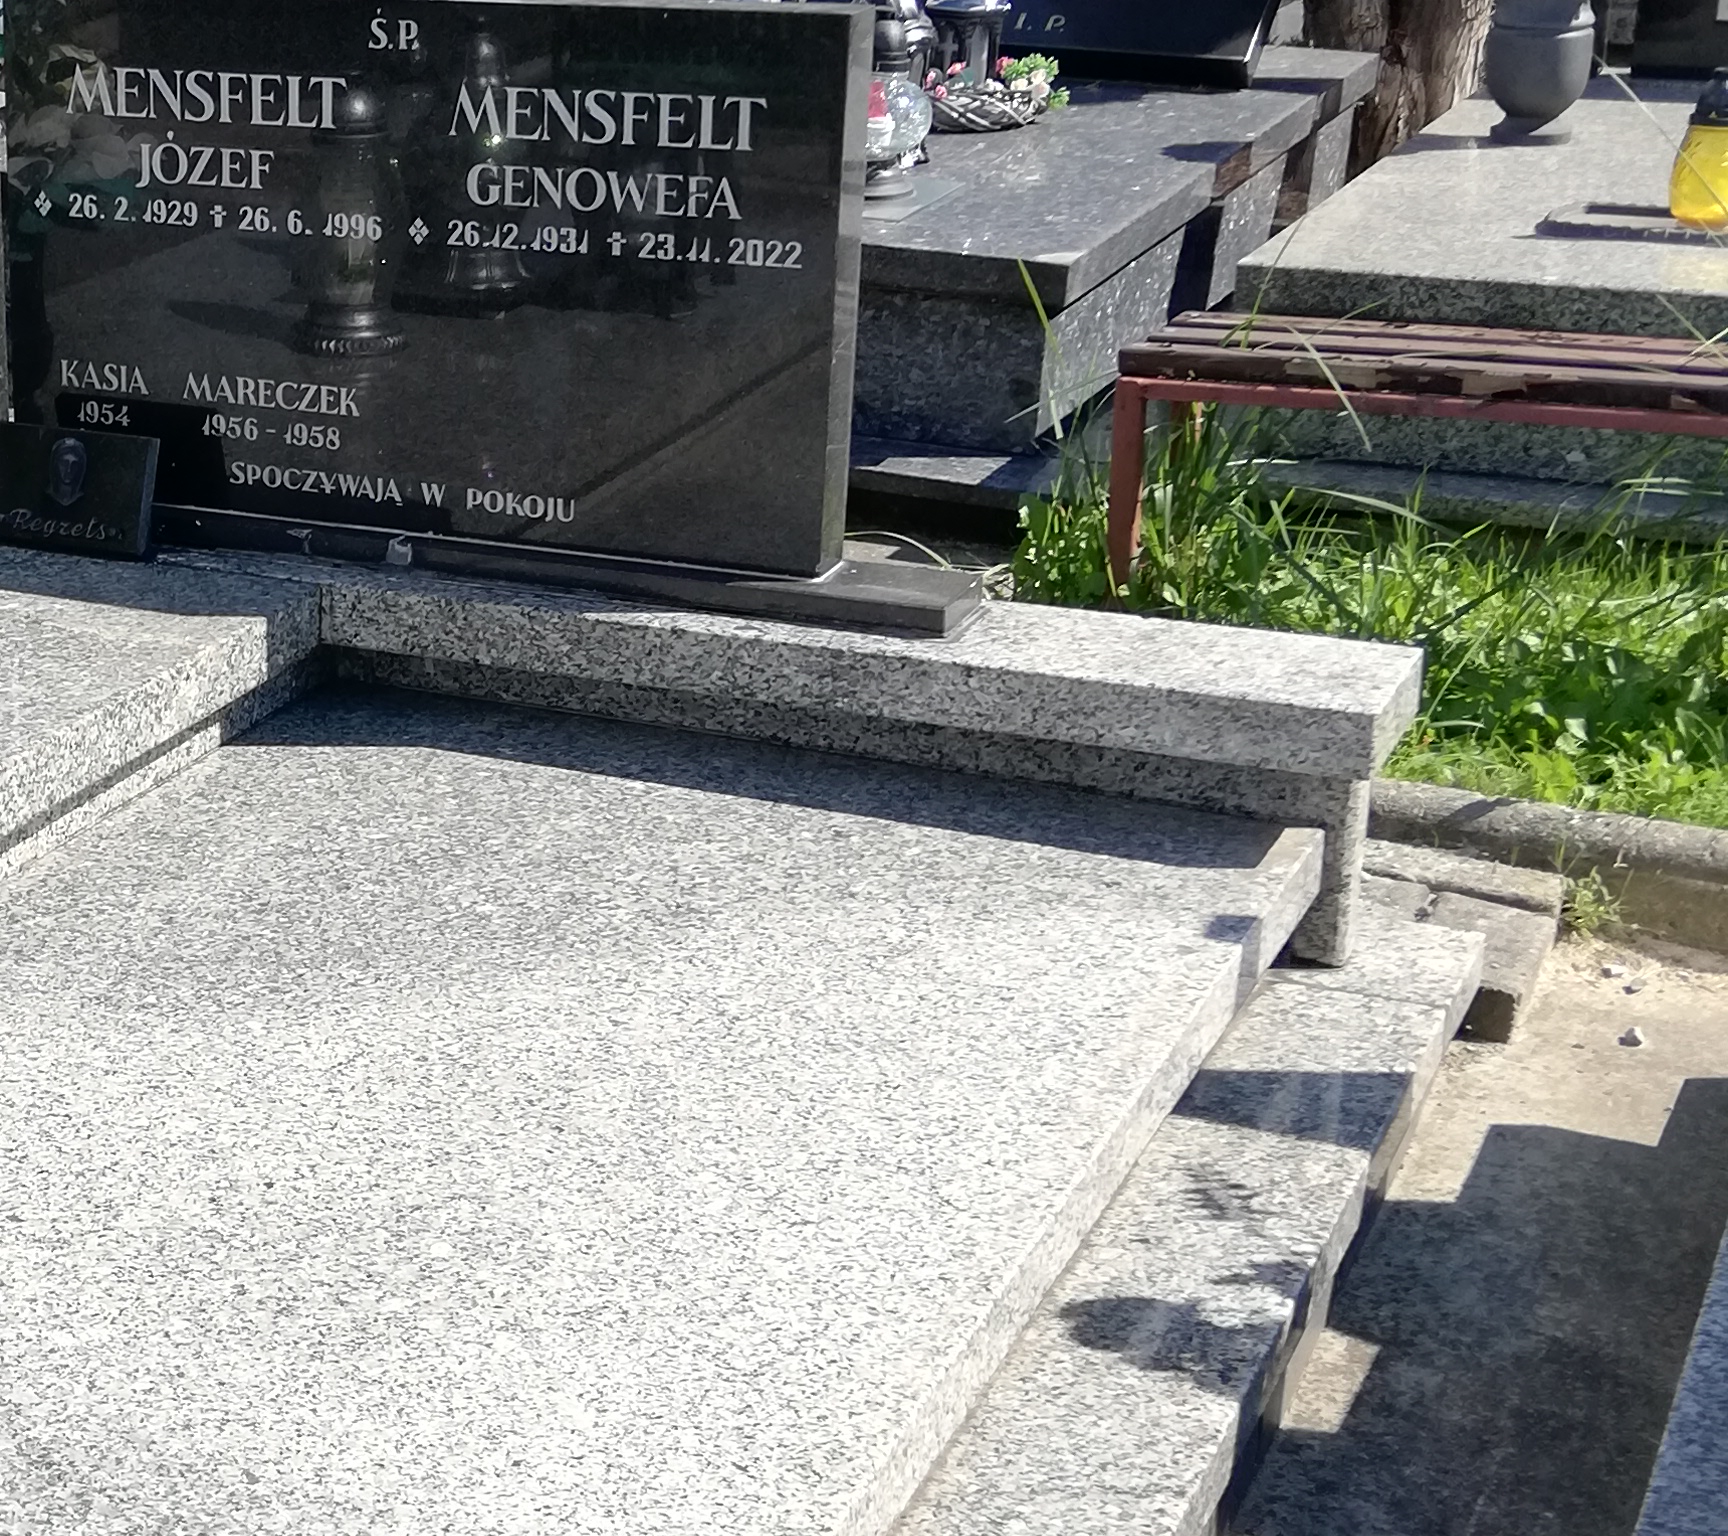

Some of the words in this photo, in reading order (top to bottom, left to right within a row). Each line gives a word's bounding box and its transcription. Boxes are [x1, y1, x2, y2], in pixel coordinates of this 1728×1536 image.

[65, 63, 348, 130] MENSFELT
[448, 80, 767, 152] MENSFELT
[135, 130, 275, 190] JÓZEF
[466, 162, 743, 221] GENOWEFA
[60, 359, 150, 396] KASIA
[182, 371, 361, 418] MARECZEK
[77, 400, 131, 428] 1954
[201, 413, 259, 443] 1956
[283, 421, 342, 451] 1958
[228, 461, 403, 507] SPOCZYWAJĄ
[419, 481, 446, 508] W
[465, 488, 576, 524] POKOJU
[9, 508, 108, 541] Regrets
